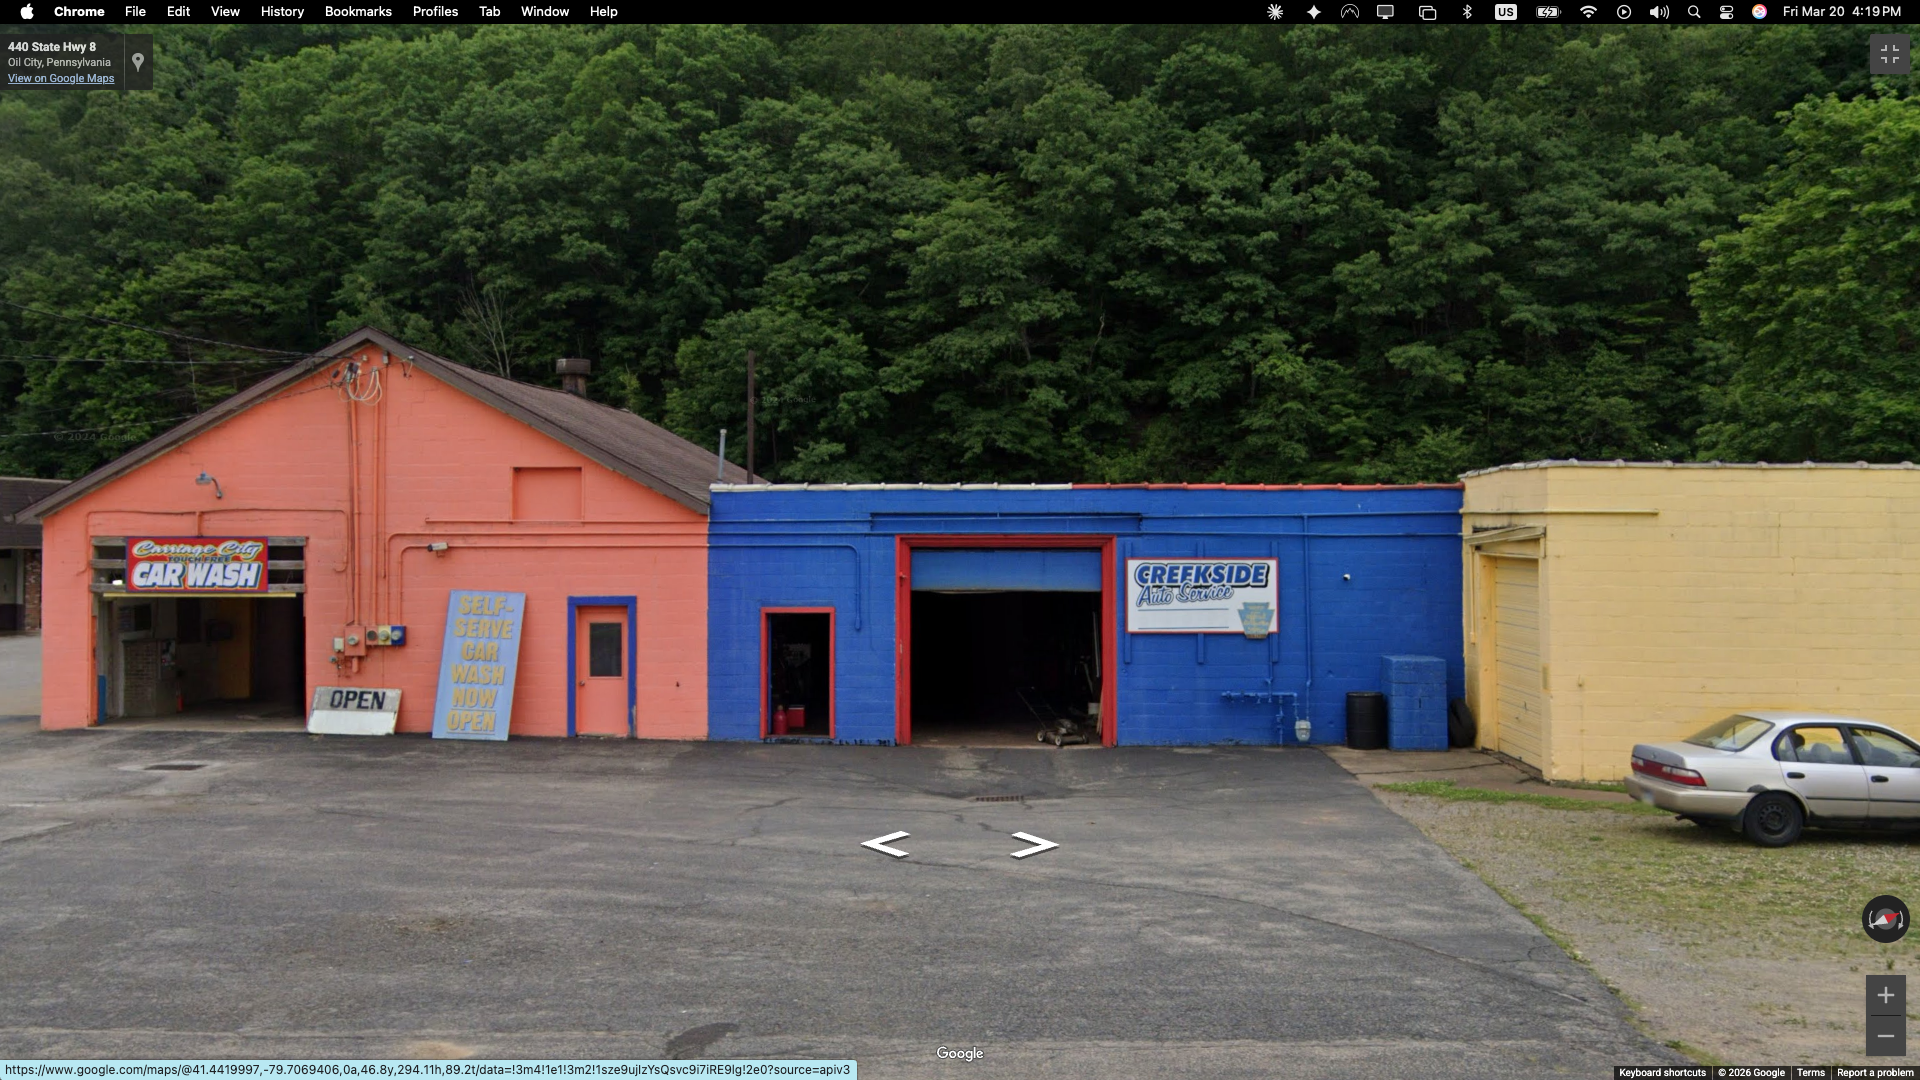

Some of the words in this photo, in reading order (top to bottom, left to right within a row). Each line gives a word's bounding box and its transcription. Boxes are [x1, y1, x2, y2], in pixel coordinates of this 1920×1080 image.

[133, 540, 216, 557] Carriage
[218, 540, 263, 559] City
[132, 561, 186, 588] CAR
[187, 561, 262, 588] WASH
[1135, 563, 1269, 587] CREEKSIDE
[1136, 585, 1173, 607] Auto
[1176, 581, 1234, 603] Service
[458, 595, 514, 616] SELF-
[454, 618, 513, 639] SERVE
[461, 641, 499, 662] CAR
[452, 664, 505, 686] WASH
[329, 689, 386, 710] OPEN
[452, 687, 498, 708] NOW
[446, 711, 496, 732] OPEN
